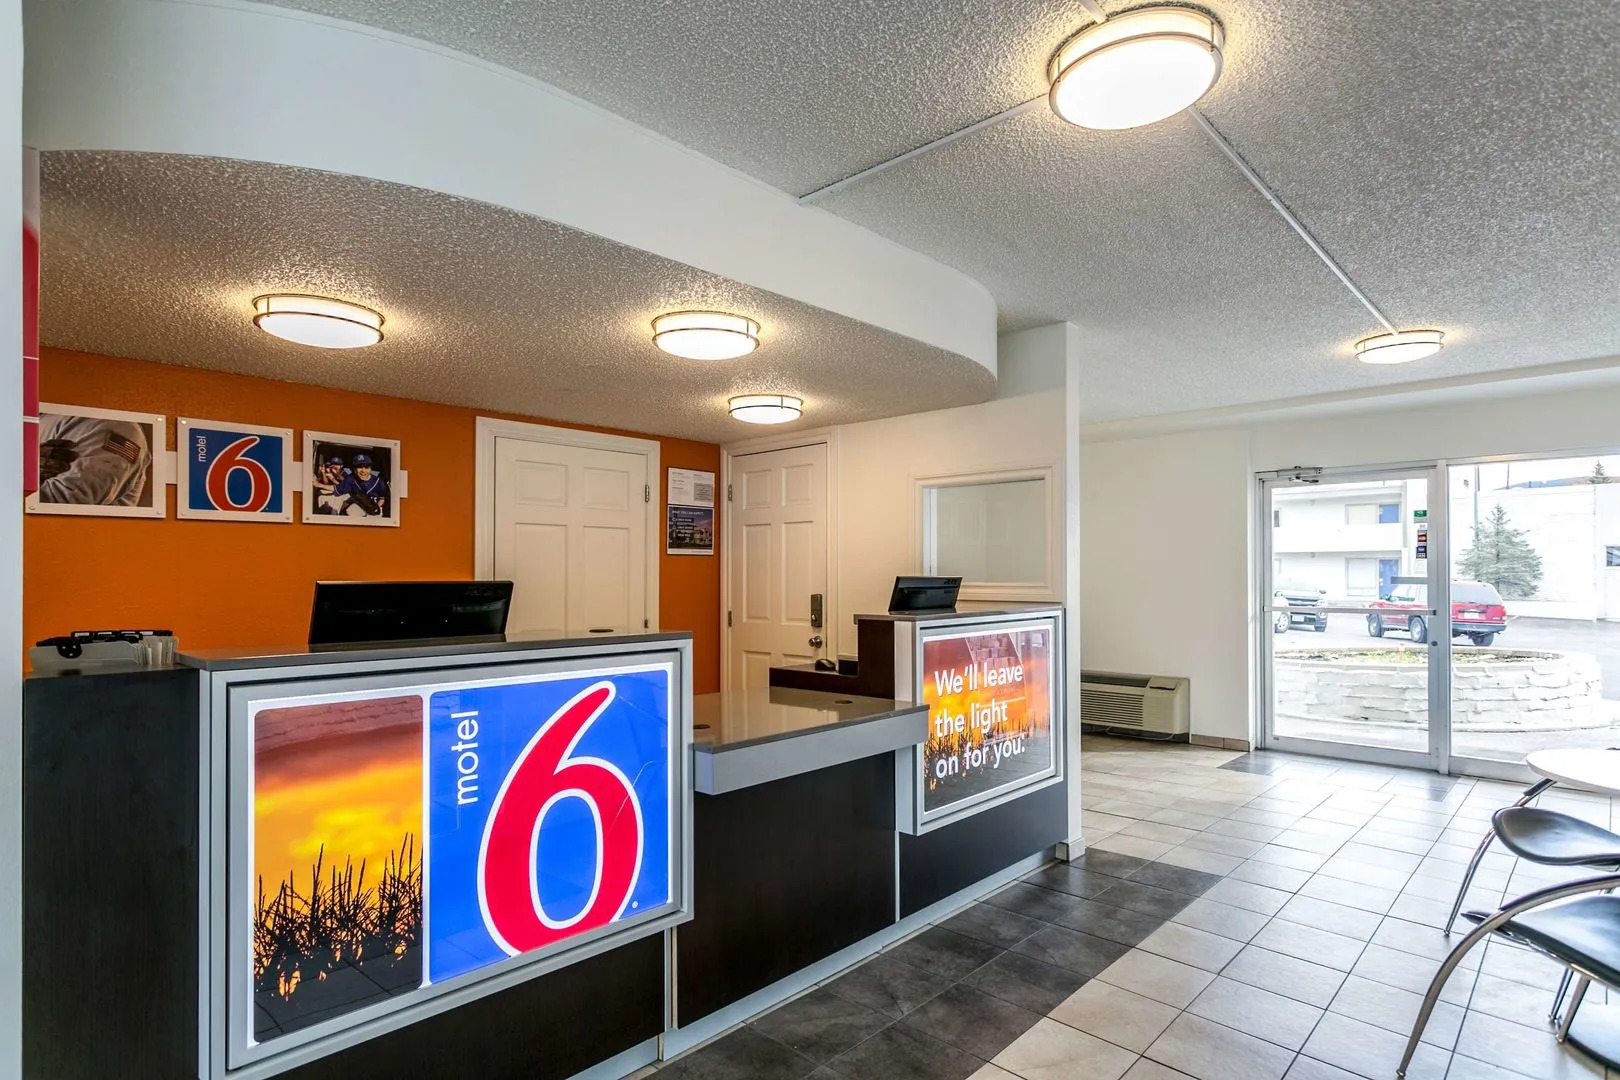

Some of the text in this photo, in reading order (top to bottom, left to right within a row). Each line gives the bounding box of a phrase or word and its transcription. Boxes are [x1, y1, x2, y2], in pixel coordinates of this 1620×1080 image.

[196, 435, 272, 512] motel 6
[934, 662, 1023, 697] We'll leave
[935, 699, 1008, 738] the light
[935, 754, 959, 779] on
[964, 742, 990, 770] for
[450, 680, 644, 957] motel 6
